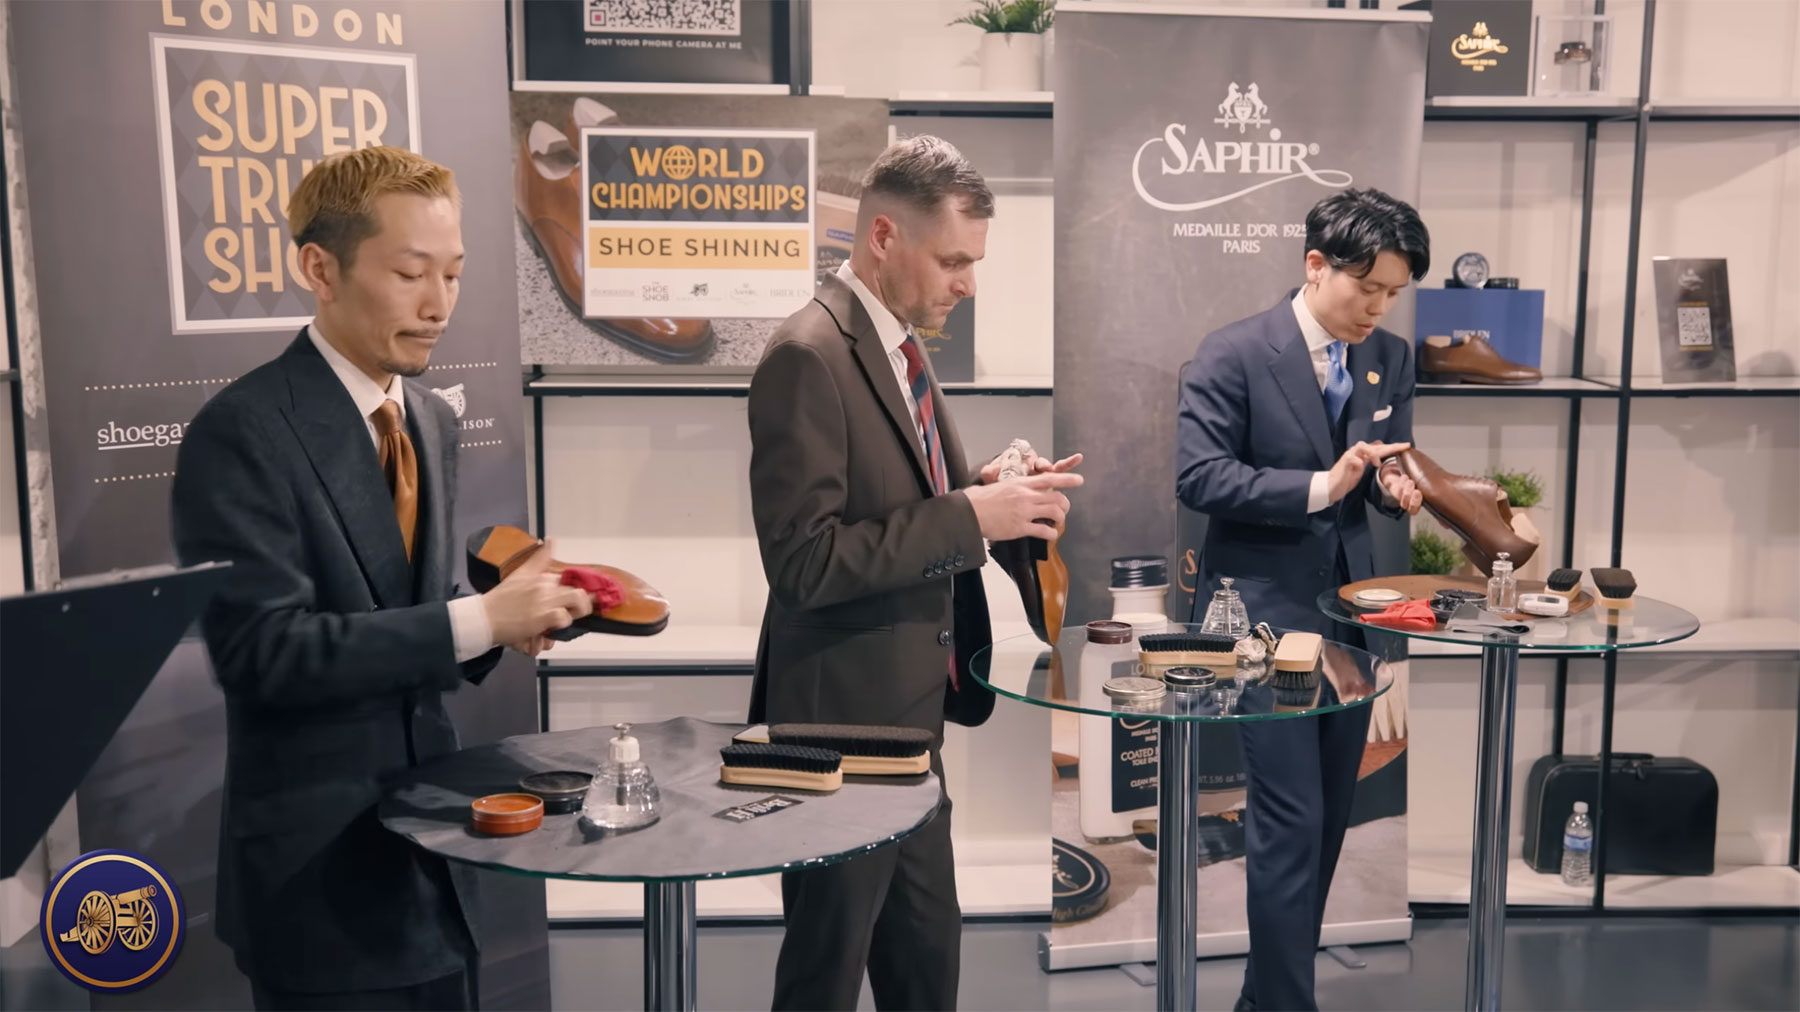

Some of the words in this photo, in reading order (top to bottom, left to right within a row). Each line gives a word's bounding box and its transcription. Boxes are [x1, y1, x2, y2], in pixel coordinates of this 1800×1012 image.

[162, 0, 403, 45] LONDON
[585, 38, 613, 46] POINT
[642, 39, 673, 47] PHONE
[676, 40, 713, 48] CAMERA
[729, 42, 742, 50] ME
[192, 79, 388, 155] SUPER
[630, 145, 765, 181] WORLD
[198, 155, 322, 223] TRU
[591, 182, 806, 211] CHAMPIONSHIPS
[1173, 223, 1241, 237] MEDAILLE
[1247, 223, 1278, 237] D'OR
[599, 238, 672, 256] SHOE
[685, 239, 800, 258] SHINING
[1223, 240, 1261, 253] PARIS
[642, 285, 669, 293] SHOE
[642, 294, 669, 302] SNOB
[459, 418, 494, 430] ISON
[97, 421, 190, 447] shoega
[1121, 748, 1154, 761] COATED
